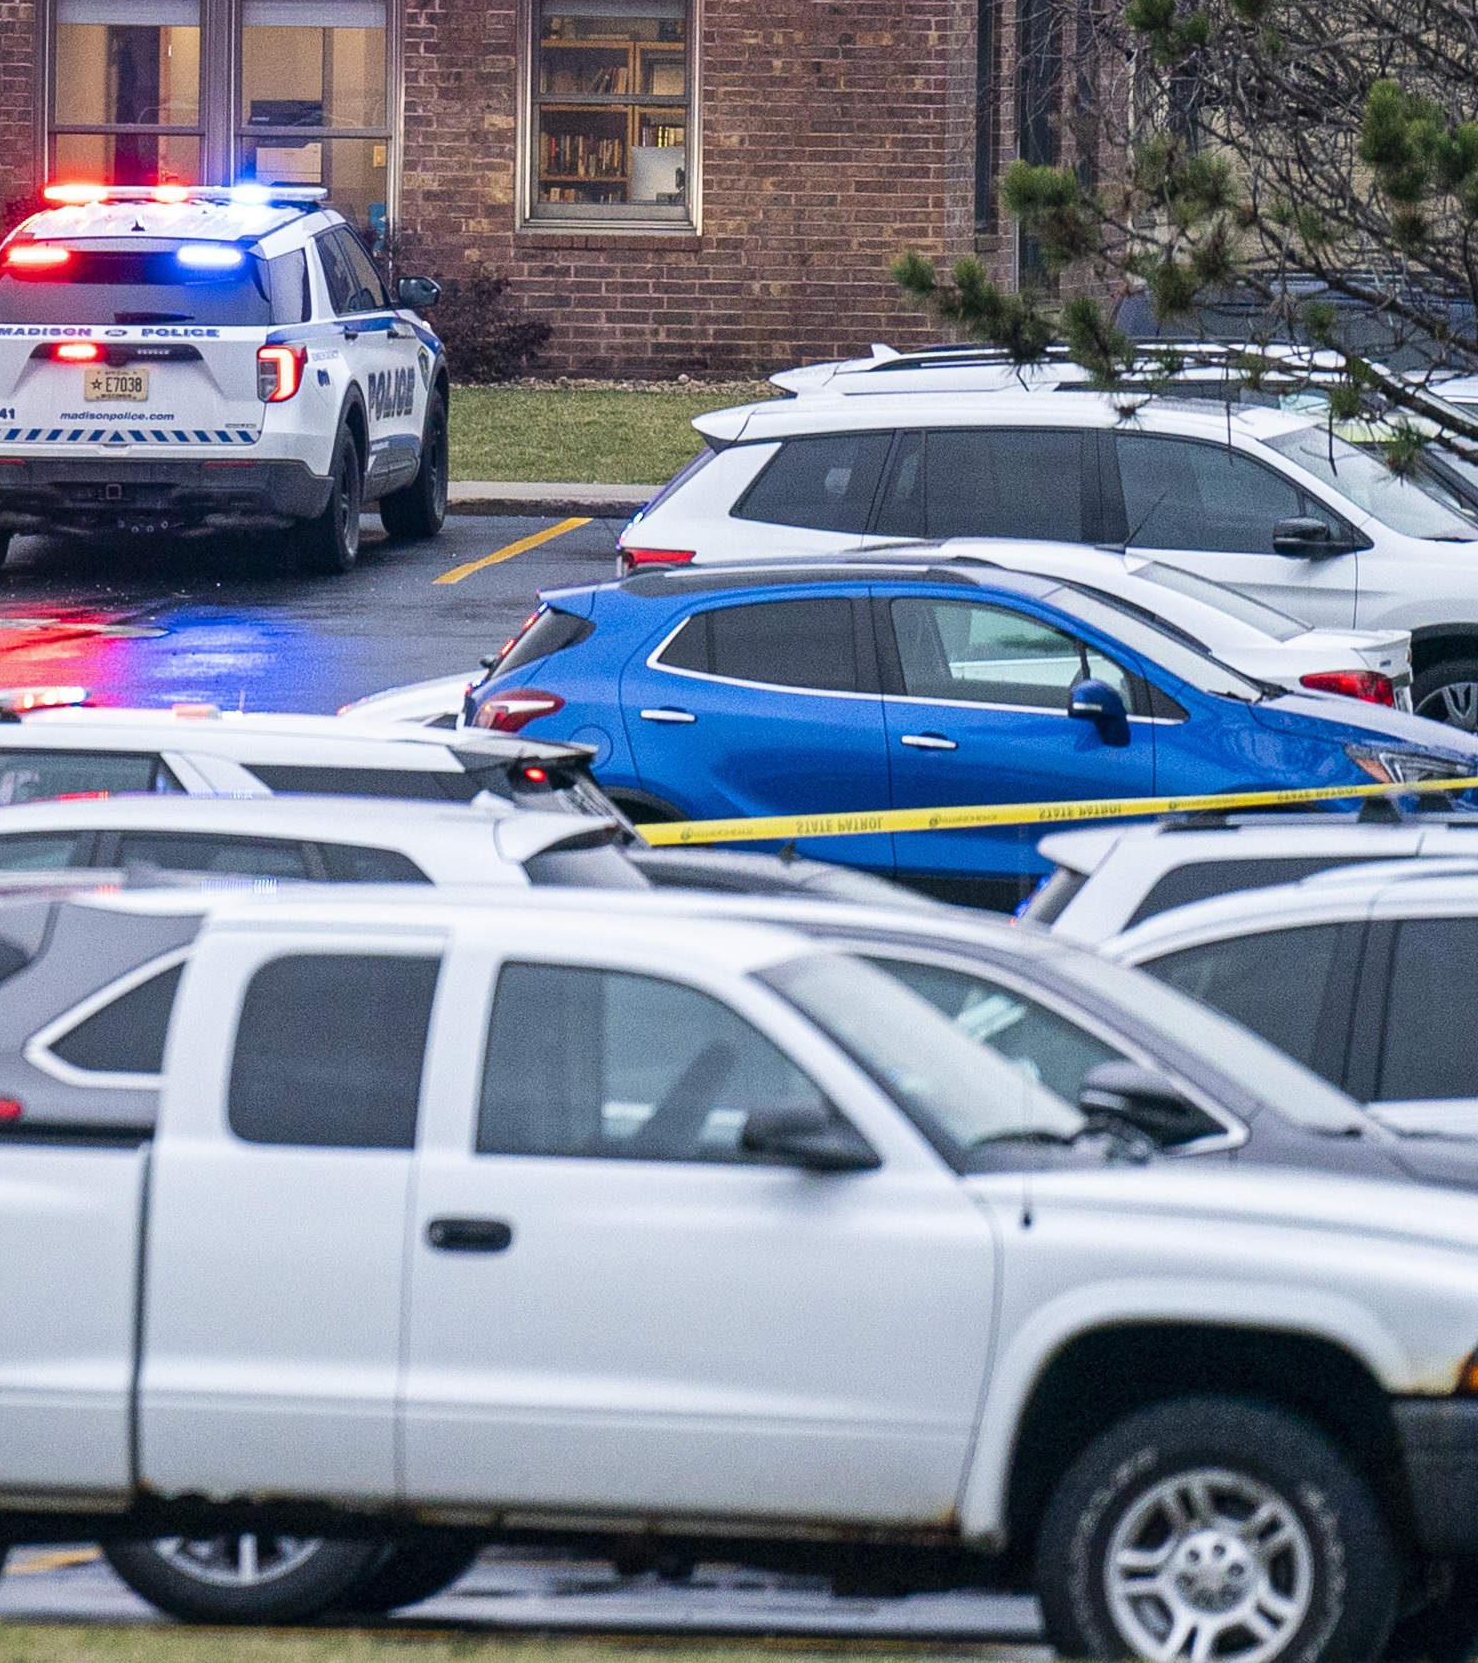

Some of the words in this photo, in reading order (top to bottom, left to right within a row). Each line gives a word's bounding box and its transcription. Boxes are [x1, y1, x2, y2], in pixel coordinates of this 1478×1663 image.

[141, 327, 220, 338] POLICE
[106, 377, 143, 393] E7038
[367, 365, 415, 422] POLICE
[59, 411, 175, 421] madisonpolice.com
